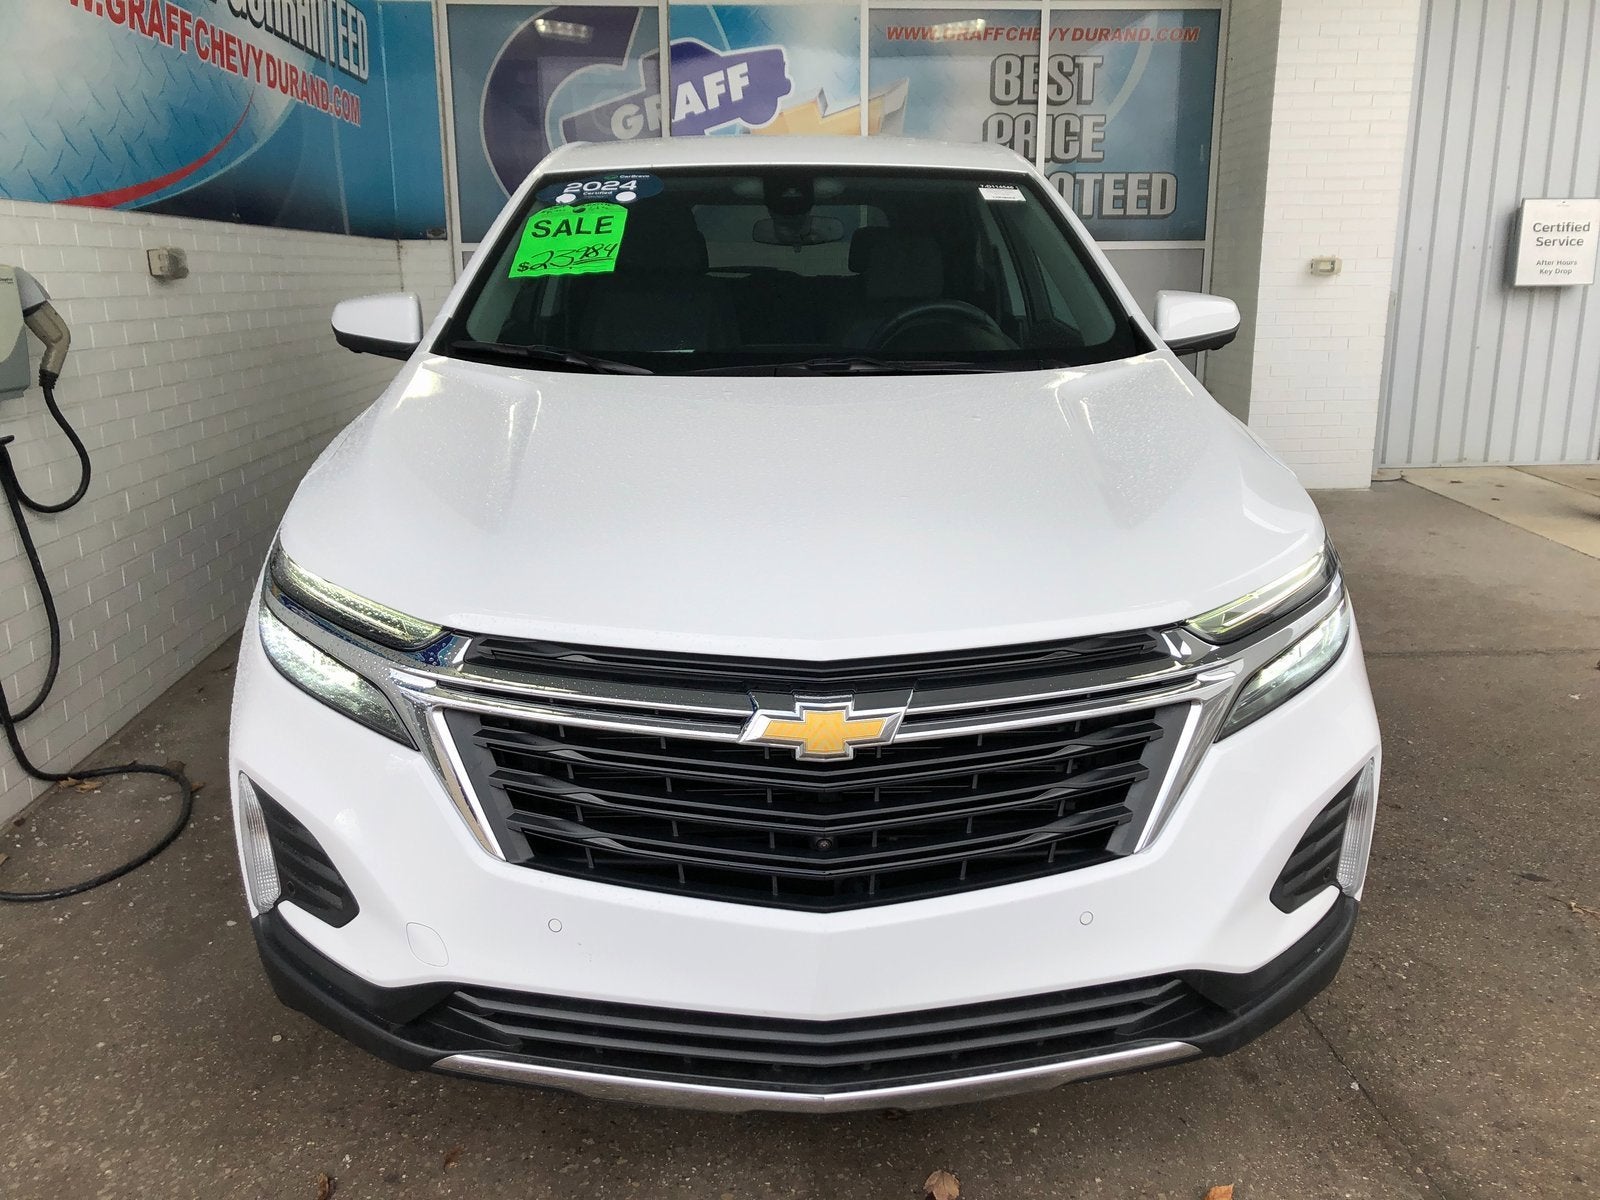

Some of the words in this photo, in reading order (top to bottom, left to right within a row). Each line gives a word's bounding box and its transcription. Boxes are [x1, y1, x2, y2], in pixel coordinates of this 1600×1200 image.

[990, 53, 1104, 106] BEST
[610, 62, 749, 139] GRAFF
[563, 180, 637, 193] 2024
[531, 216, 614, 238] SALE
[1533, 222, 1591, 232] Certified
[1536, 236, 1584, 247] Service
